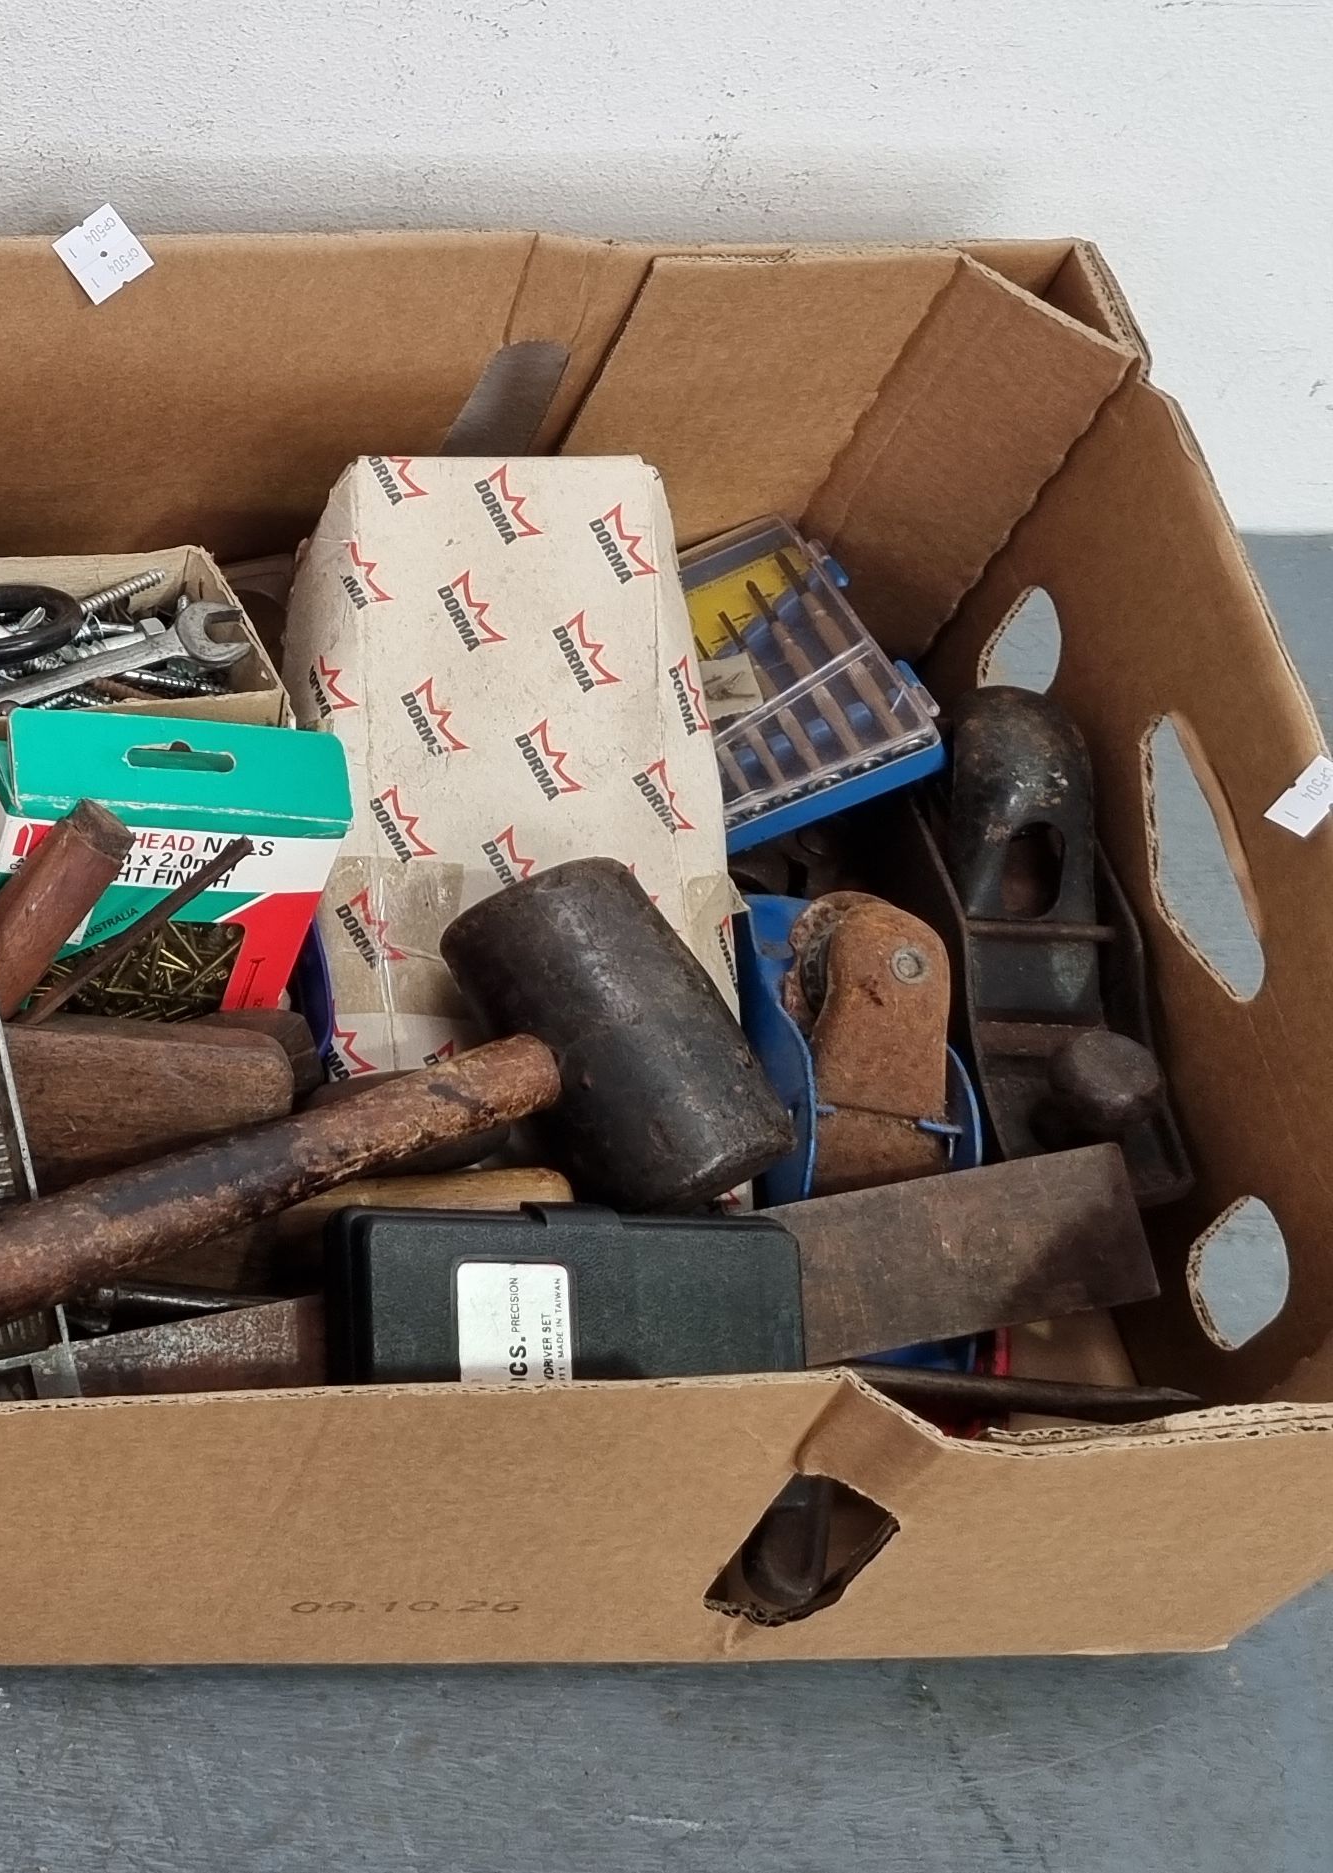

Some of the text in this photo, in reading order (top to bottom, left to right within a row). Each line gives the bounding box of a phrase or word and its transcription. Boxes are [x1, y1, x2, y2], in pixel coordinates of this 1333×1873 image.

[83, 217, 116, 245] CP504
[108, 248, 139, 275] CP504
[474, 478, 518, 545] DORMA
[589, 517, 633, 585] DORMA
[437, 584, 481, 652] DORMA
[552, 624, 595, 694] DORMA
[668, 667, 698, 736] DORMA
[515, 733, 561, 801] DORMA
[370, 798, 413, 864] DORMA
[632, 772, 677, 835] DORMA
[132, 831, 194, 852] HEAD
[509, 1277, 520, 1333] PRECISION
[541, 1313, 552, 1333] SET
[554, 1278, 562, 1313] TAIWAN
[555, 1318, 562, 1328] IN
[556, 1332, 565, 1359] MADE
